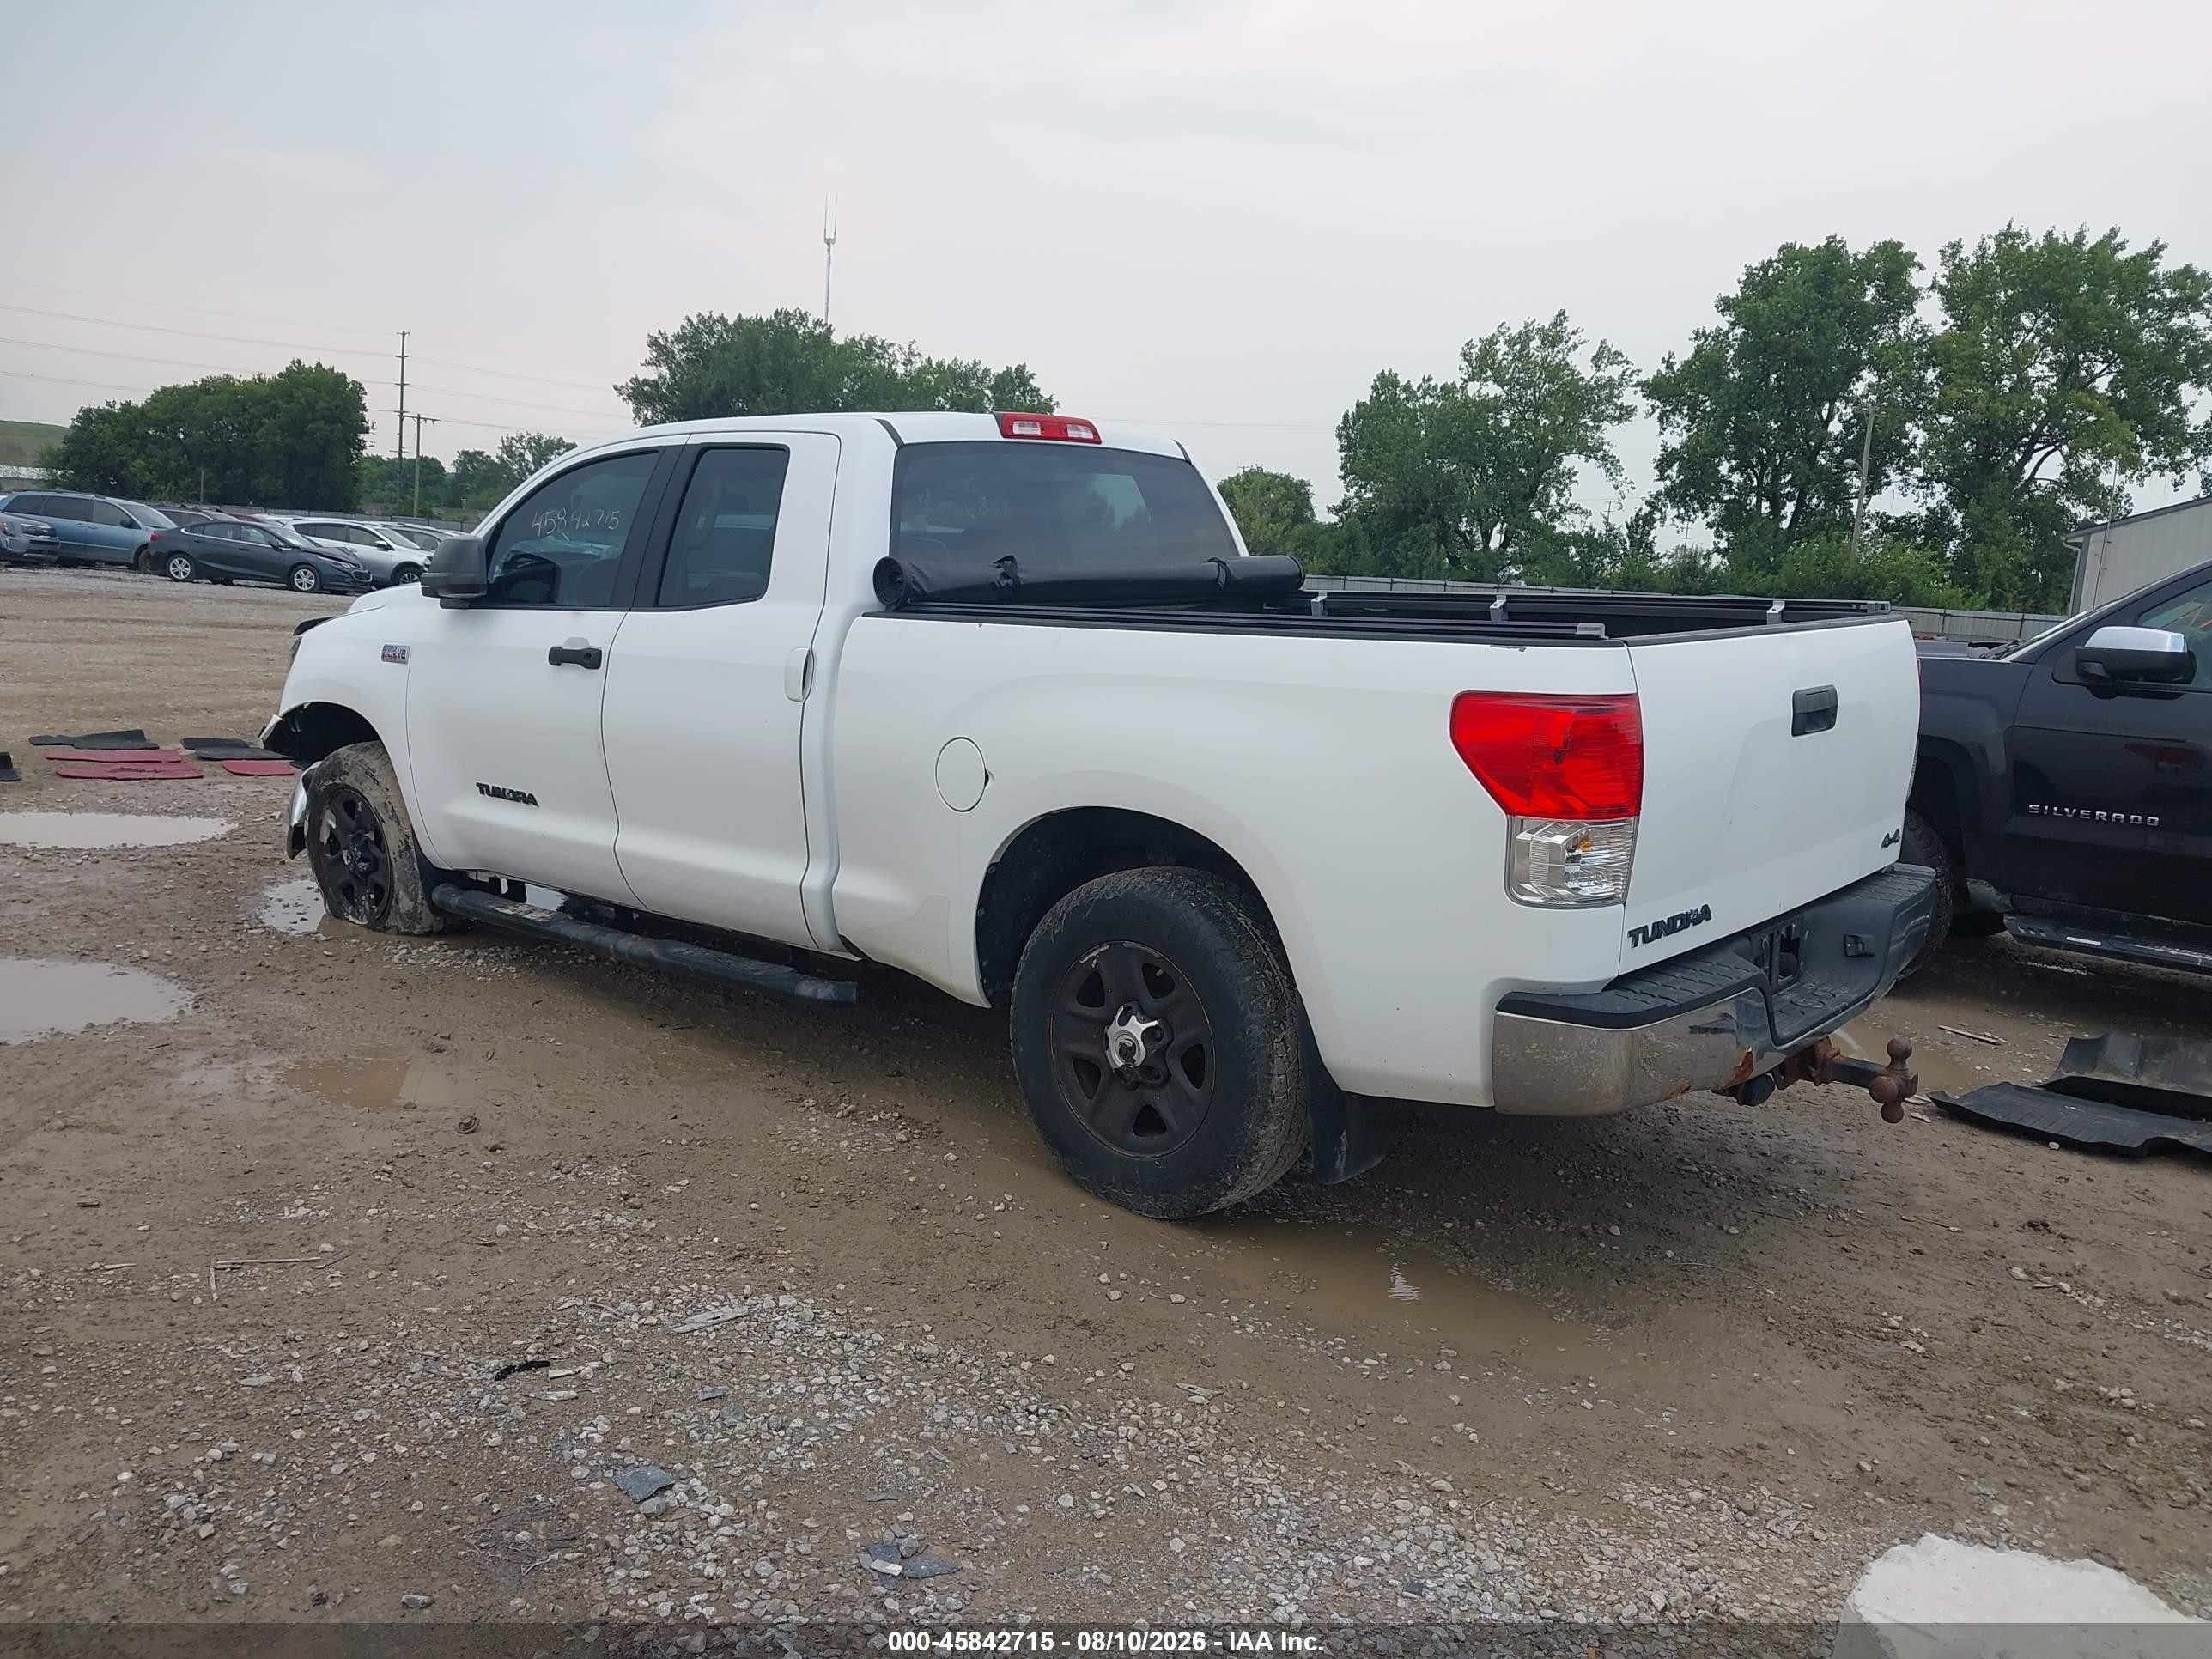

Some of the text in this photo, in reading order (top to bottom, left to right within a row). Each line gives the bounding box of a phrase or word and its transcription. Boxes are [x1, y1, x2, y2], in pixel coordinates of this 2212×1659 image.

[476, 781, 539, 807] TUNDRA
[2027, 804, 2160, 827] SILVERADO
[1627, 904, 1712, 949] TUNDRA
